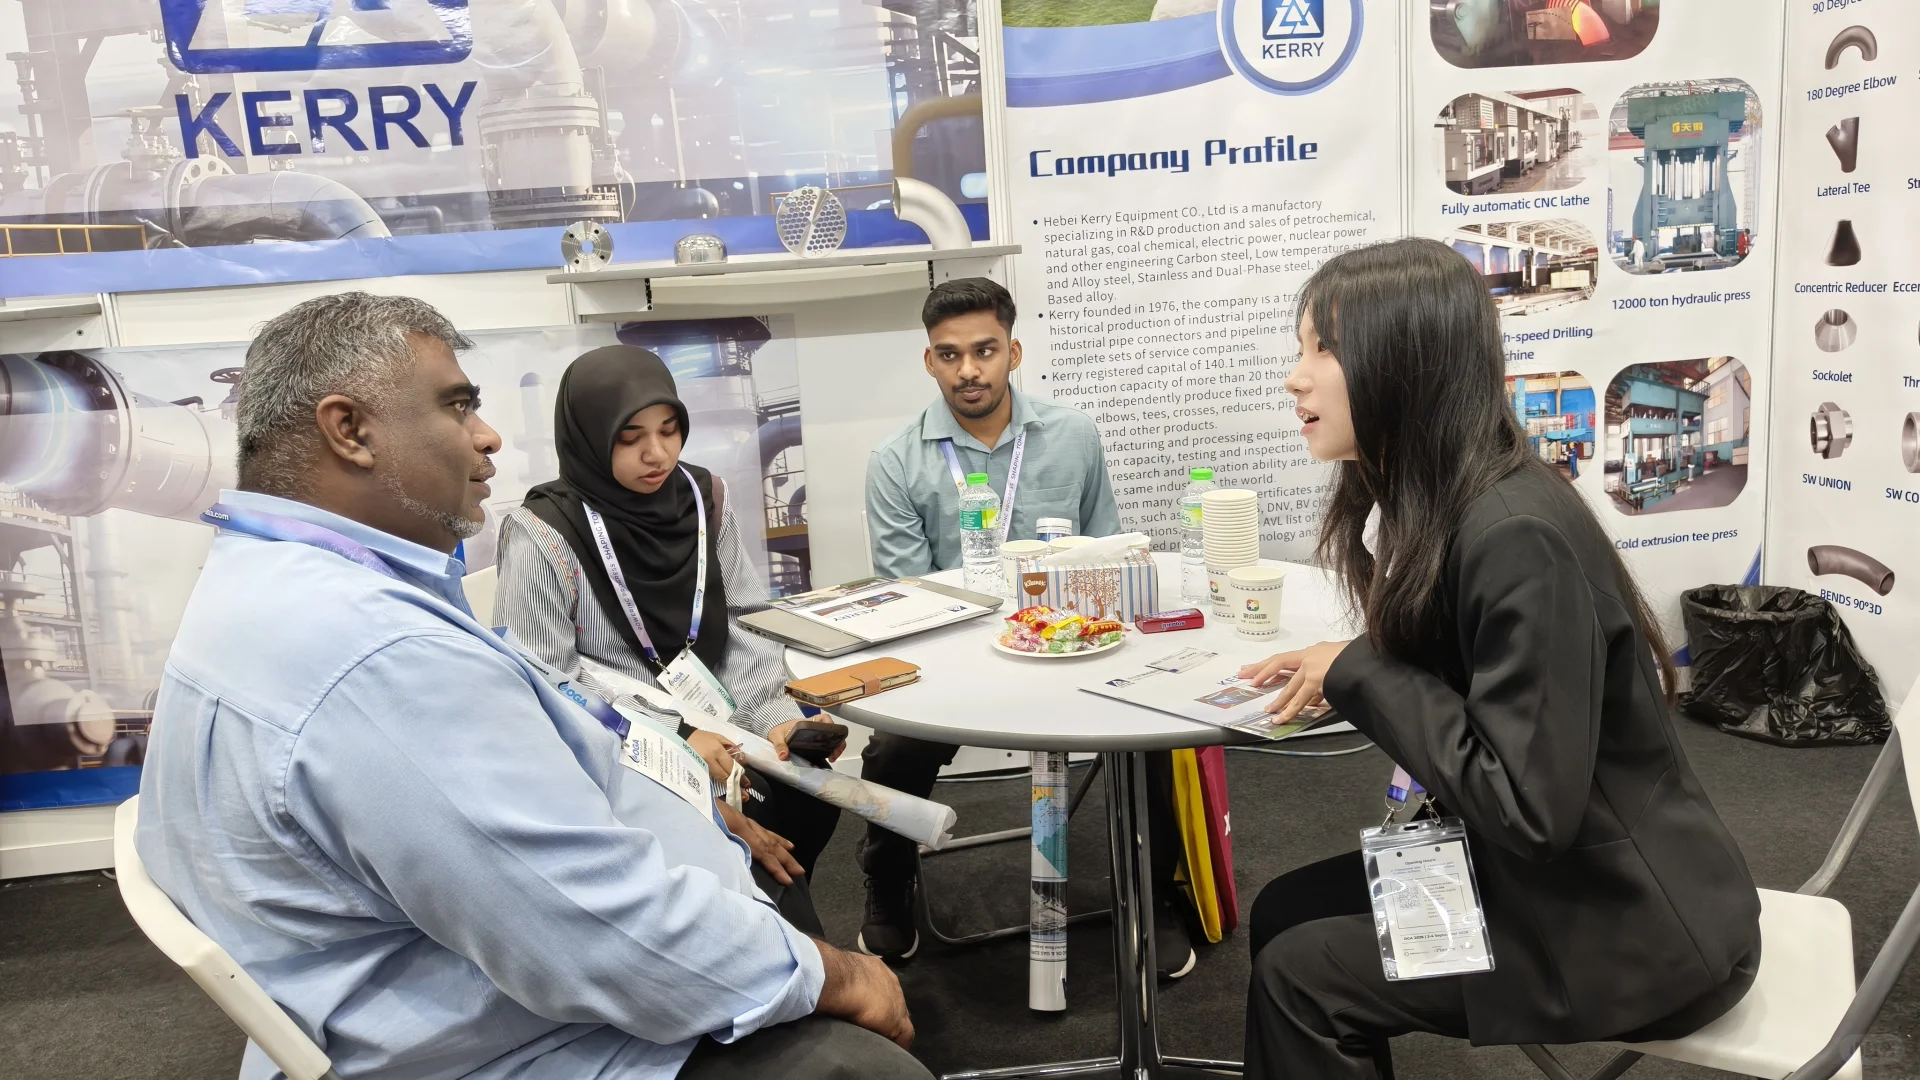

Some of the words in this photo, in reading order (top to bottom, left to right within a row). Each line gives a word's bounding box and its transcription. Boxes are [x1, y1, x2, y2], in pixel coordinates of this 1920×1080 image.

[1813, 1, 1825, 14] 90
[1827, 0, 1861, 11] Degr
[1262, 42, 1324, 59] KERRY
[1806, 88, 1823, 101] 180
[1825, 82, 1861, 98] Degree
[1863, 75, 1897, 90] Elbow
[174, 81, 478, 160] KERRY
[1029, 149, 1190, 178] Company
[1204, 134, 1318, 167] Profile
[1817, 182, 1851, 197] Lateral
[1853, 182, 1871, 194] Tee
[1043, 214, 1077, 227] Hebei
[1081, 213, 1112, 226] Kerry
[1115, 208, 1178, 224] Equipment
[1181, 206, 1205, 219] CO.,
[1207, 204, 1226, 216] Ltd
[1251, 199, 1323, 213] manufactory
[1441, 202, 1470, 216] Fully
[1472, 198, 1531, 213] automatic
[1534, 196, 1558, 209] CNC
[1560, 194, 1590, 207] lathe
[1044, 228, 1114, 245] specializing
[1130, 225, 1154, 237] R&D
[1157, 221, 1220, 237] production
[1223, 218, 1246, 231] and
[1249, 216, 1277, 229] sales
[1293, 210, 1376, 228] petrochemical,
[1045, 244, 1088, 259] natural
[1091, 246, 1114, 258] gas,
[1117, 241, 1141, 254] coal
[1143, 237, 1198, 252] chemical,
[1201, 234, 1245, 248] electric
[1247, 232, 1287, 246] power,
[1289, 229, 1331, 241] nuclear
[1333, 227, 1367, 241] power
[1046, 262, 1068, 275] and
[1071, 260, 1103, 273] other
[1105, 255, 1174, 272] engineering
[1176, 251, 1218, 265] Carbon
[1220, 249, 1253, 262] steel,
[1255, 248, 1278, 259] Low
[1281, 243, 1350, 258] temperature
[1046, 277, 1069, 290] and
[1072, 275, 1101, 289] Alloy
[1103, 273, 1135, 286] steel,
[1137, 270, 1188, 283] Stainless
[1191, 265, 1213, 278] and
[1216, 263, 1281, 277] Dual-Phase
[1284, 260, 1314, 272] steel,
[1048, 291, 1083, 305] Based
[1086, 290, 1117, 303] alloy.
[1794, 281, 1843, 293] Concentric
[1845, 281, 1888, 293] Reducer
[1049, 309, 1080, 321] Kerry
[1083, 304, 1131, 318] founded
[1149, 300, 1180, 313] 1976,
[1182, 299, 1201, 310] the
[1204, 296, 1258, 310] company
[1612, 297, 1647, 310] 12000
[1649, 297, 1669, 307] ton
[1671, 291, 1722, 307] hydraulic
[1724, 290, 1751, 304] press
[1049, 320, 1104, 336] historical
[1107, 318, 1171, 334] production
[1188, 310, 1244, 325] industrial
[1247, 307, 1294, 323] pipeline
[1050, 336, 1106, 351] industrial
[1109, 335, 1134, 349] pipe
[1137, 330, 1202, 345] connectors
[1205, 327, 1227, 339] and
[1230, 324, 1277, 339] pipeline
[1503, 328, 1550, 345] h-speed
[1552, 326, 1593, 339] Drilling
[1051, 353, 1106, 367] complete
[1109, 351, 1132, 362] sets
[1149, 346, 1190, 359] service
[1192, 341, 1259, 356] companies.
[1052, 371, 1083, 382] Kerry
[1086, 364, 1144, 381] registered
[1147, 360, 1187, 376] capital
[1204, 357, 1235, 370] 140.1
[1238, 355, 1278, 367] million
[1812, 369, 1853, 383] Sockolet
[1053, 384, 1117, 399] production
[1120, 378, 1169, 392] capacity
[1186, 376, 1216, 387] more
[1219, 372, 1245, 384] than
[1248, 370, 1262, 382] 20
[1903, 375, 1920, 388] Thr
[1097, 393, 1182, 409] independently
[1184, 387, 1232, 403] produce
[1235, 384, 1262, 397] fixed
[1095, 411, 1140, 424] elbows,
[1142, 409, 1170, 420] tees,
[1173, 405, 1219, 418] crosses,
[1222, 402, 1275, 414] reducers,
[1104, 426, 1126, 438] and
[1129, 424, 1161, 436] other
[1164, 420, 1218, 435] products.
[1168, 436, 1189, 447] and
[1192, 432, 1254, 448] processing
[1123, 453, 1175, 467] capacity,
[1177, 449, 1217, 462] testing
[1219, 446, 1241, 457] and
[1244, 442, 1304, 457] inspection
[1112, 468, 1160, 482] research
[1163, 465, 1185, 477] and
[1252, 457, 1288, 471] ability
[1290, 459, 1308, 467] are
[1123, 485, 1154, 496] same
[1220, 475, 1238, 487] the
[1240, 473, 1277, 485] world.
[1802, 473, 1817, 485] SW
[1818, 476, 1852, 491] UNION
[1117, 500, 1139, 511] won
[1142, 498, 1173, 509] many
[1885, 487, 1903, 500] SW
[1905, 491, 1920, 504] CO
[1140, 511, 1165, 523] such
[1169, 511, 1181, 521] as
[1267, 502, 1293, 513] DNV,
[1296, 498, 1309, 509] BV
[1262, 516, 1283, 527] AVL
[1286, 513, 1302, 525] list
[598, 526, 613, 560] SHAPING
[1615, 538, 1639, 550] Cold
[1641, 533, 1689, 547] extrusion
[1692, 531, 1710, 542] tee
[1711, 528, 1738, 542] press
[1820, 588, 1851, 606] BENDS
[566, 688, 588, 708] OGA
